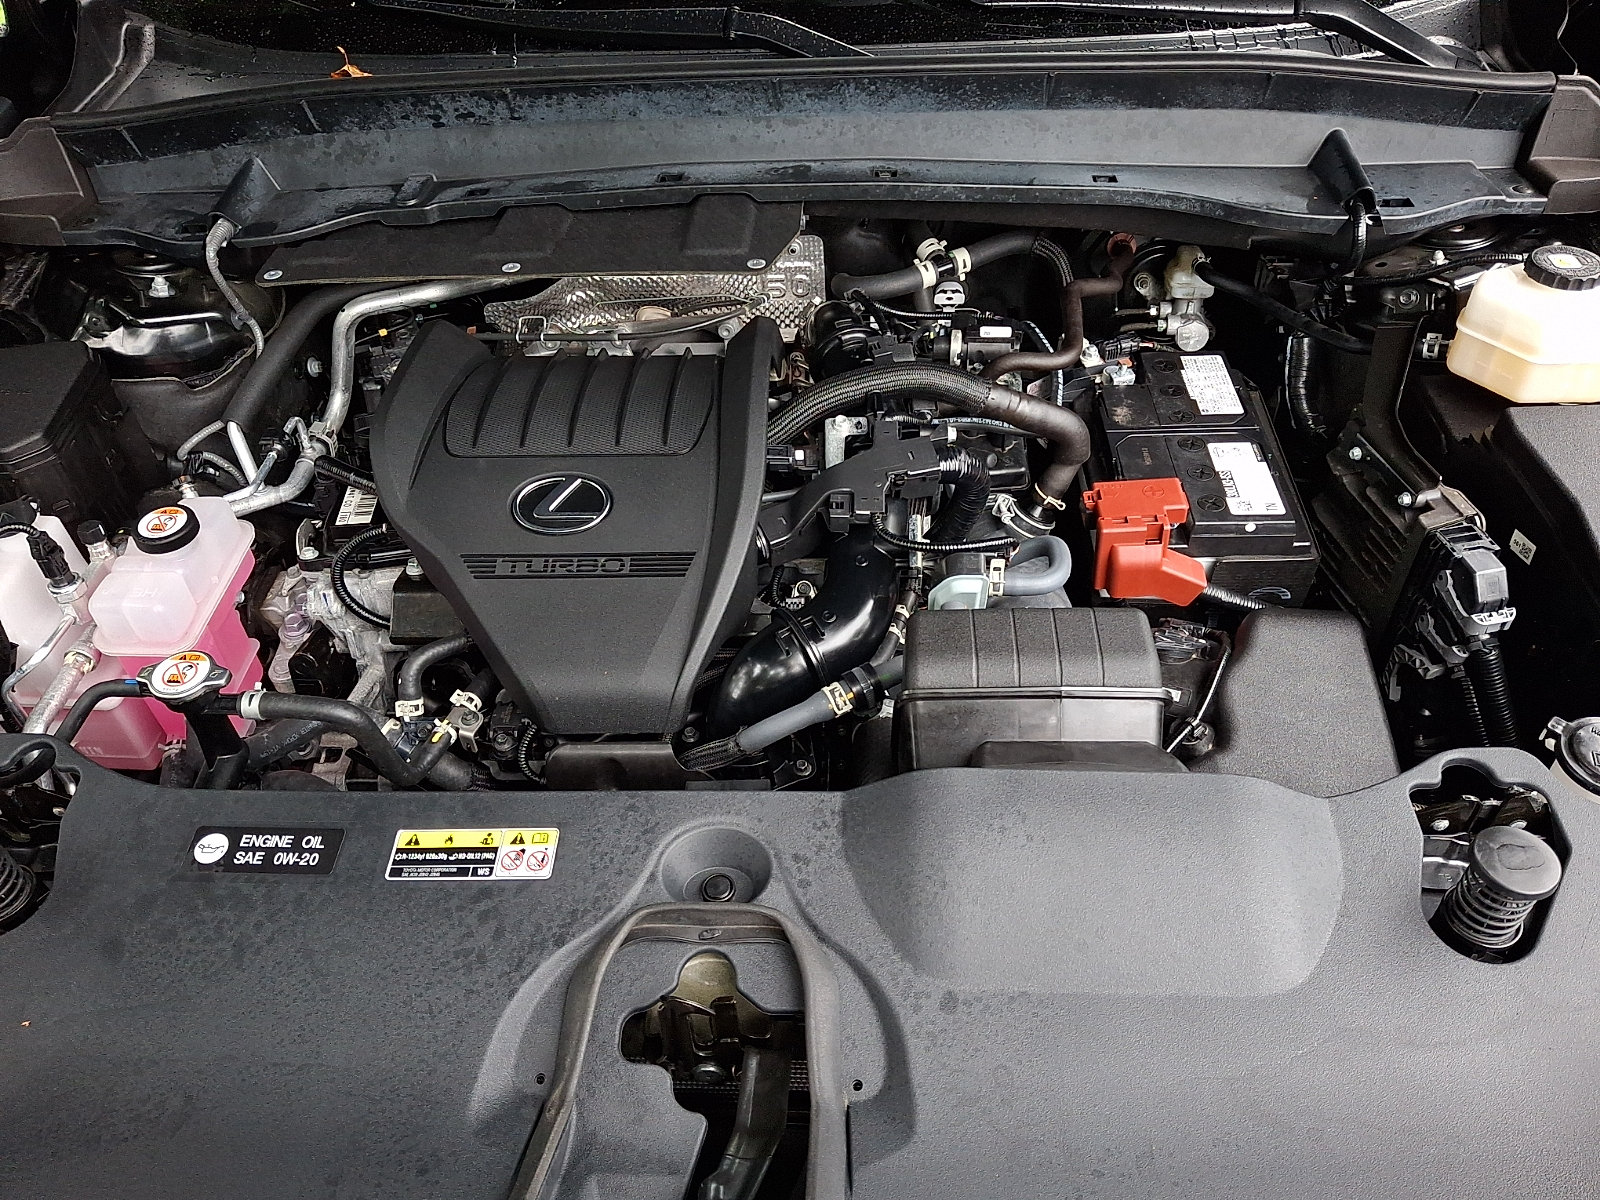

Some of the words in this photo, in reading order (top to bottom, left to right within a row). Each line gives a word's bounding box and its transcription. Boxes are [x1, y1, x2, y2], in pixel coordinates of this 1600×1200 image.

[501, 557, 627, 574] TURBO
[239, 834, 295, 848] ENGINE
[301, 835, 325, 849] OIL
[233, 851, 266, 865] SAE
[273, 852, 320, 866] 0W-20
